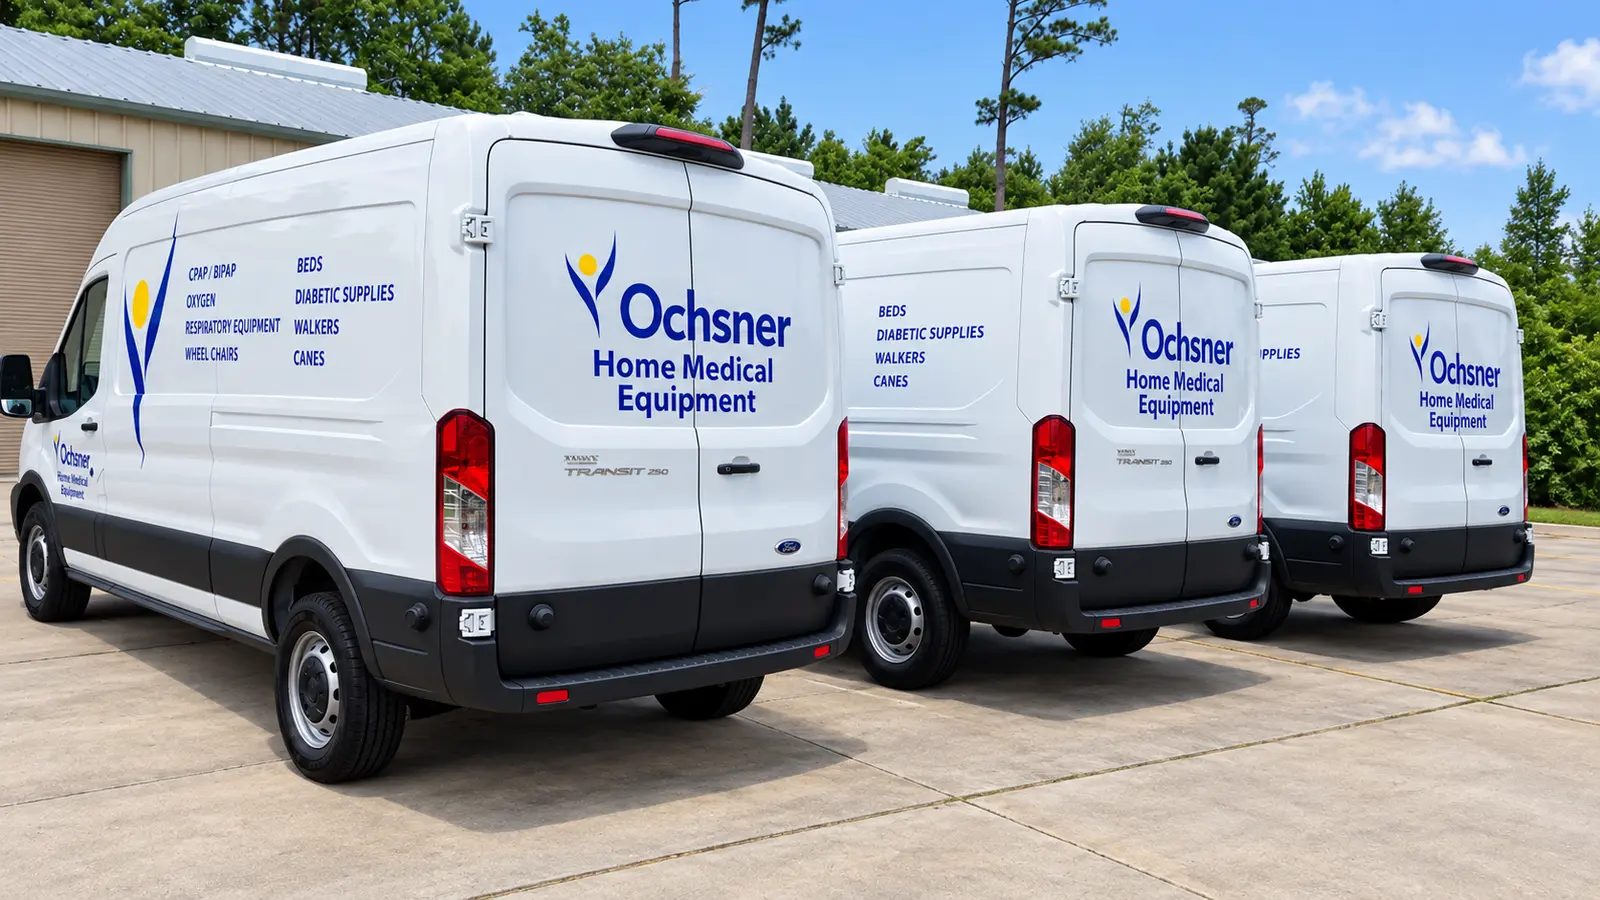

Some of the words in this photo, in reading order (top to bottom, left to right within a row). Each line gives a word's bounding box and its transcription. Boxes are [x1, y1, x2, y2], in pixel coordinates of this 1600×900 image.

[188, 266, 208, 281] CPAP
[214, 263, 237, 279] BIPAP
[297, 256, 323, 273] BEDS
[186, 293, 216, 308] OXYGEN
[295, 286, 340, 305] DIABETIC
[342, 283, 395, 302] SUPPLIES
[620, 282, 791, 348] Ochsner
[878, 304, 907, 319] BEDS
[185, 319, 232, 335] RESPIRATORY
[233, 317, 281, 334] EQUIPMENT
[294, 318, 340, 336] WALKERS
[876, 327, 927, 342] DIABETIC
[929, 325, 985, 340] SUPPLIES
[1141, 317, 1234, 366] Ochsner
[185, 346, 209, 361] WHEEL
[210, 346, 239, 361] CHAIRS
[293, 349, 325, 367] CANES
[875, 351, 926, 365] WALKERS
[1260, 348, 1301, 360] PPLIES
[594, 349, 676, 380] Home
[683, 354, 773, 383] Medical
[1429, 350, 1501, 388] Ochsner
[873, 374, 909, 389] CANES
[1126, 368, 1171, 393] Home
[1173, 370, 1224, 393] Medical
[618, 384, 756, 419] Equipment
[1138, 394, 1214, 421] Equipment
[1419, 391, 1453, 409] Home
[1455, 393, 1495, 410] Medical
[1429, 411, 1488, 432] Equipment
[60, 443, 90, 469] Ochsner
[564, 467, 646, 477] TRANSIT
